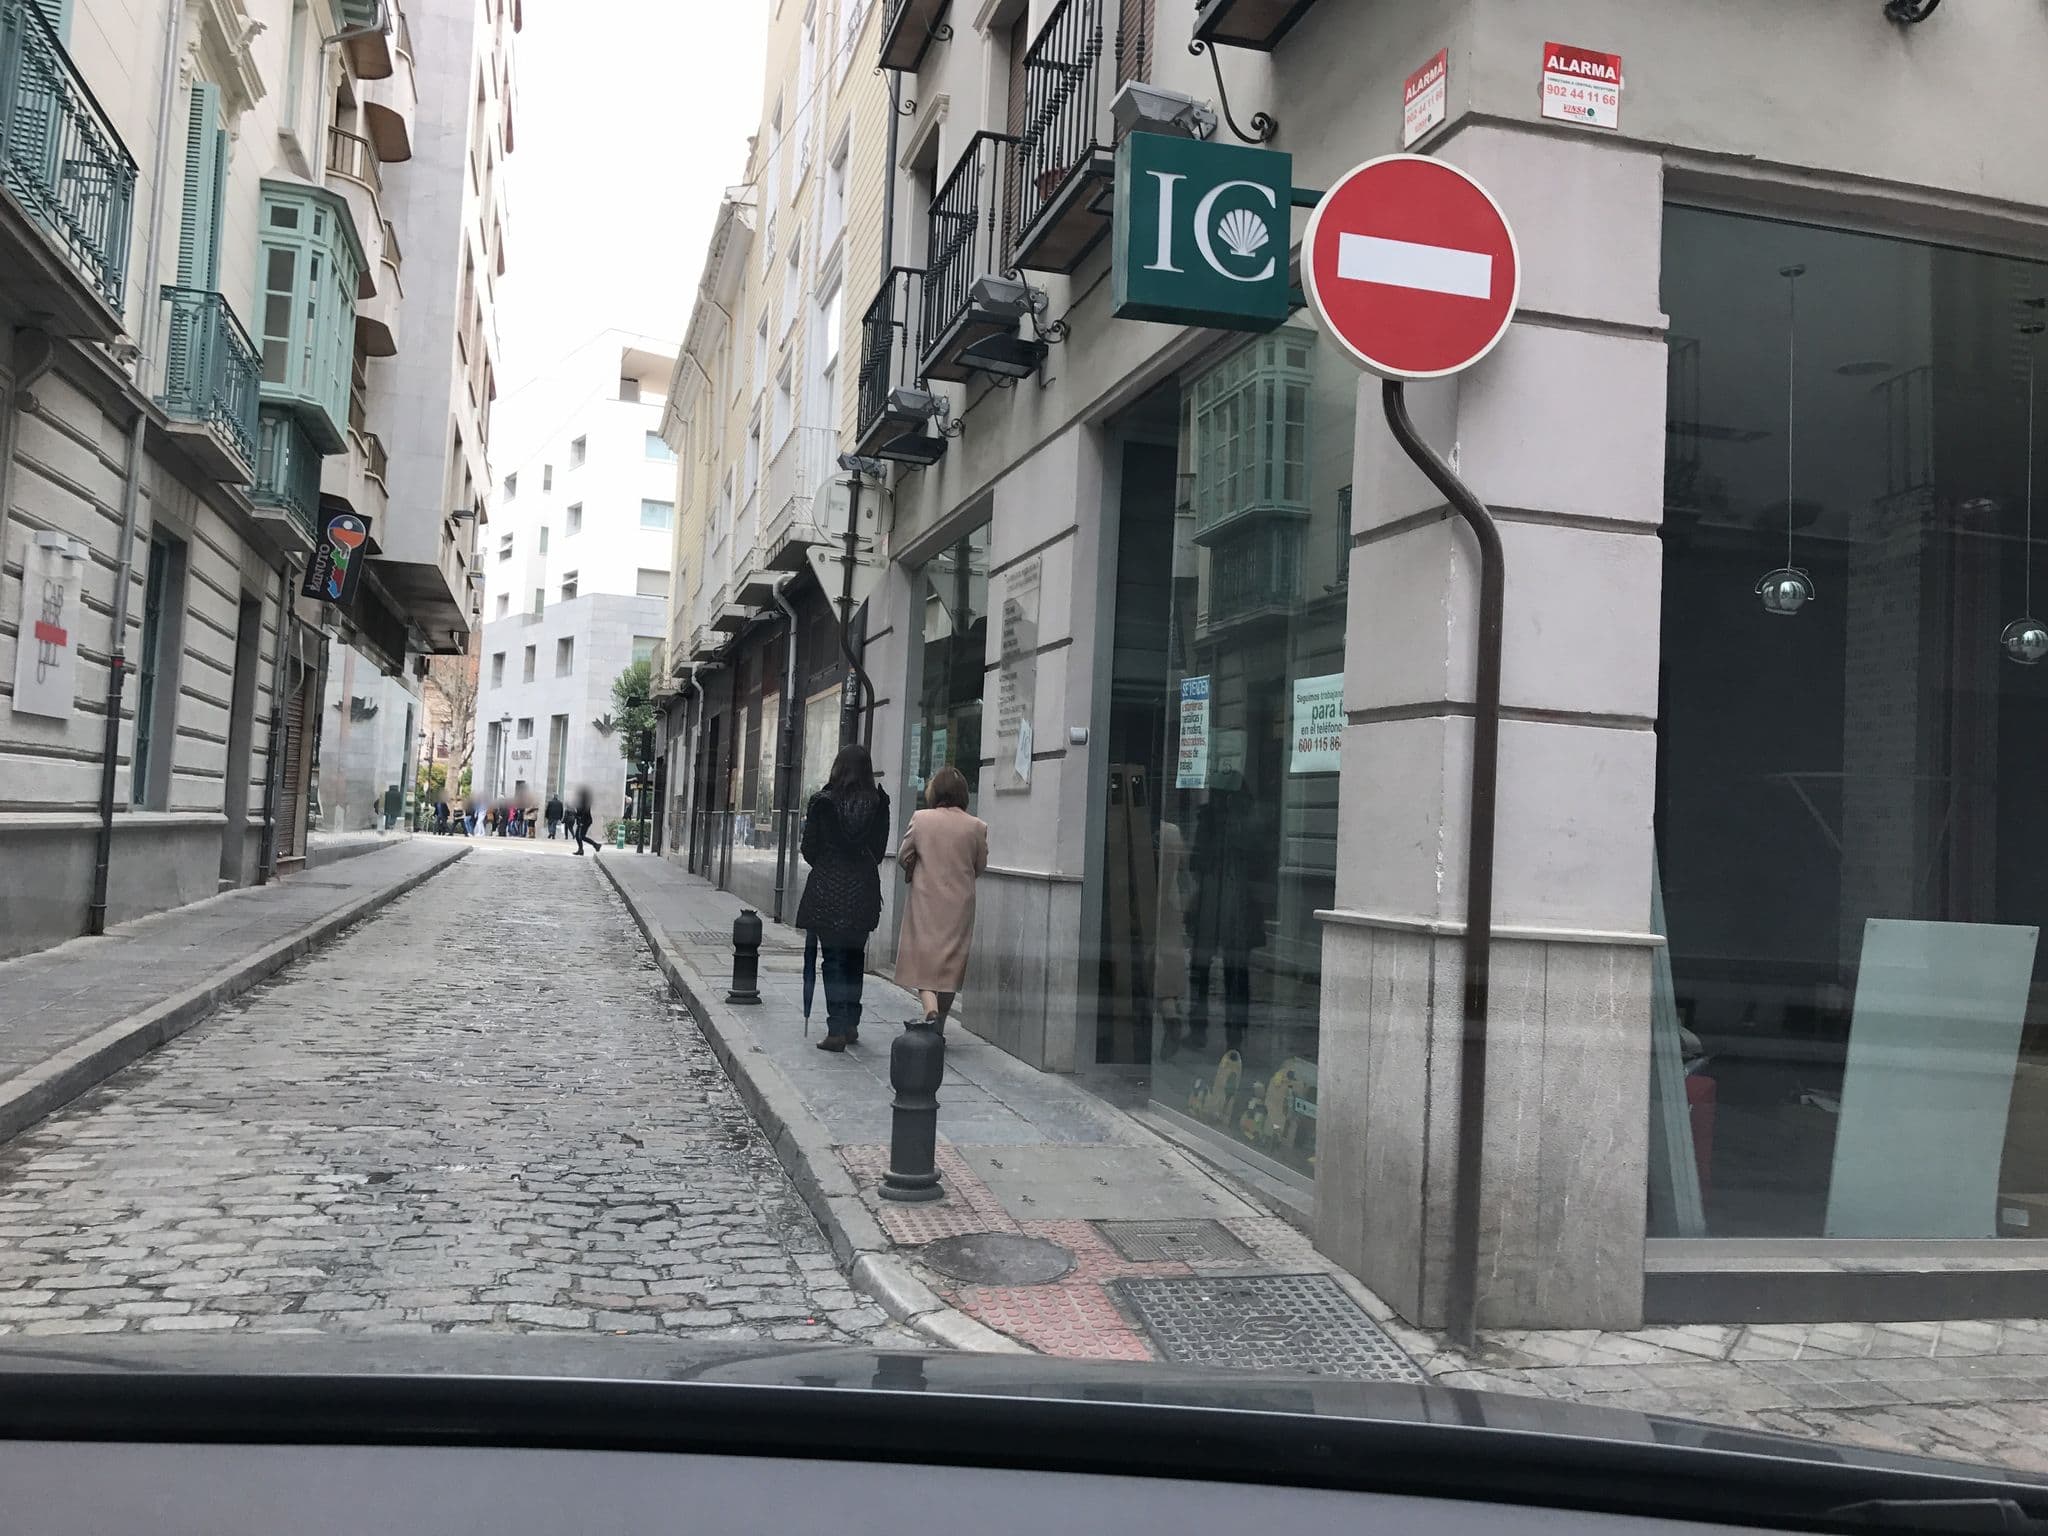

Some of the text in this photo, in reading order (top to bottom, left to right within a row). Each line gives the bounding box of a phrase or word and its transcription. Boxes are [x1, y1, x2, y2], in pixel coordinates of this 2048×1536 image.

[1547, 54, 1617, 80] ALARMA
[1405, 61, 1443, 102] ALARMA
[1547, 84, 1616, 106] 902 44 11 66
[1311, 699, 1344, 725] para t
[1301, 726, 1309, 735] en
[1310, 724, 1316, 735] el
[1298, 738, 1312, 752] 600
[1314, 737, 1328, 752] 115
